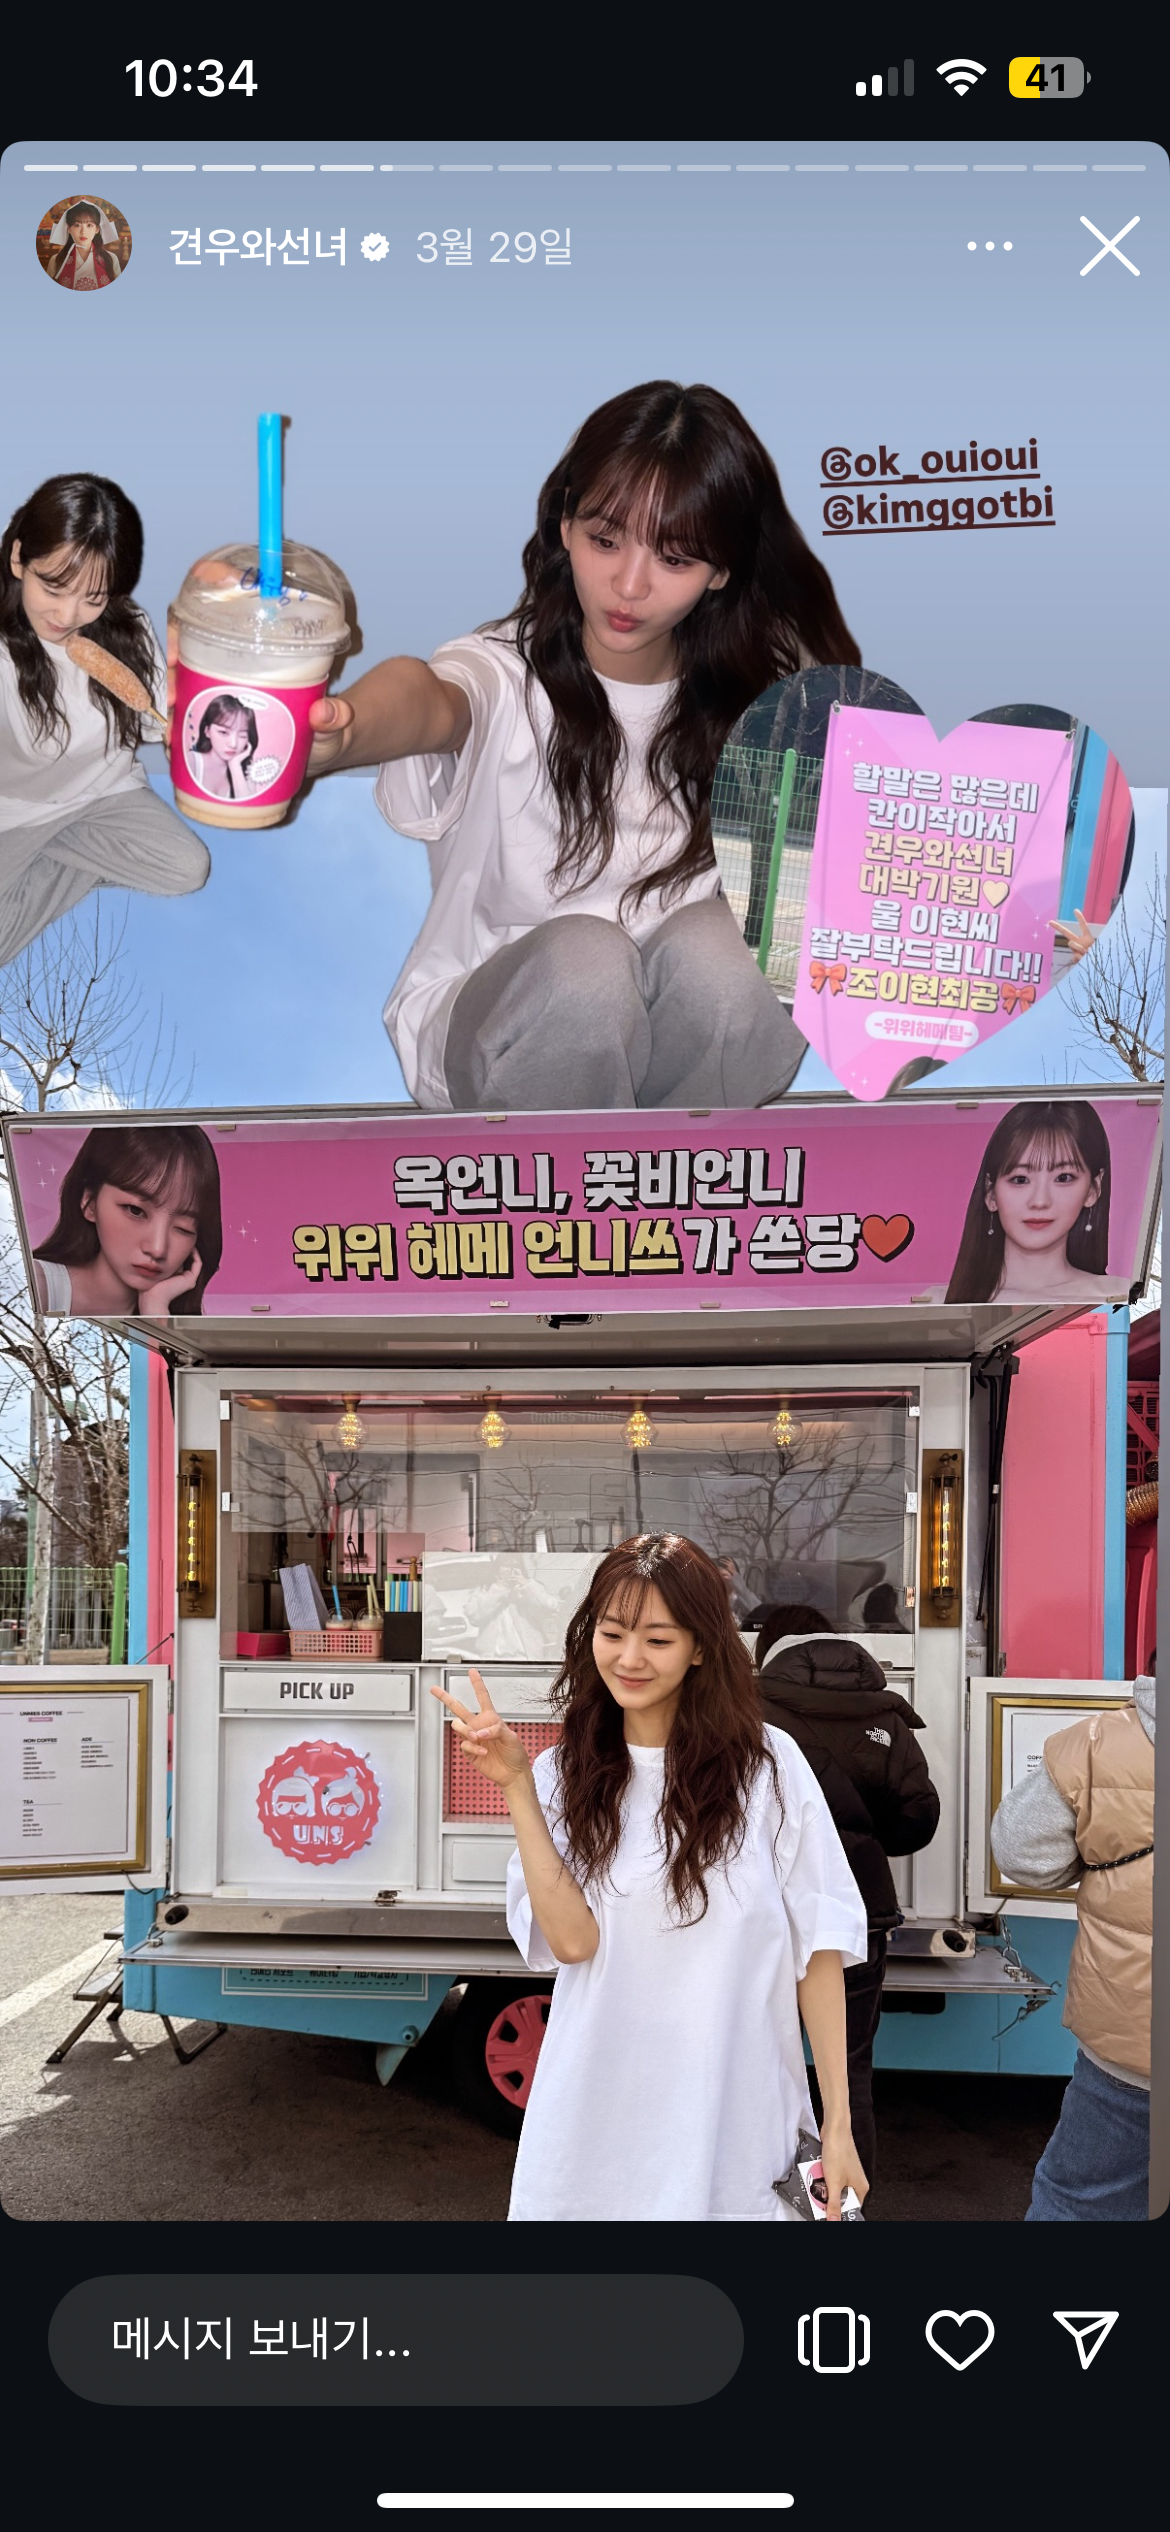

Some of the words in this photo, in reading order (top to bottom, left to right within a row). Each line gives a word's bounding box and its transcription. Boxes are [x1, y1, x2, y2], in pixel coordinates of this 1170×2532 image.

[852, 761, 942, 802] 할말은
[949, 773, 1039, 813] 많은데
[866, 797, 1018, 844] 칸이작아서
[863, 830, 1015, 878] 견우와선녀
[858, 863, 981, 908] 대박기원
[870, 899, 901, 932] 울
[909, 903, 1000, 943] 이현씨
[809, 926, 1044, 984] 잘부탁드립니다!!
[845, 966, 999, 1014] 조이현최공
[393, 1152, 573, 1215] 옥언니,
[582, 1146, 806, 1213] 꽃비언니
[292, 1222, 398, 1282] 위위
[406, 1220, 515, 1281] 헤메
[747, 1212, 862, 1275] 쏜당
[279, 1682, 324, 1700] PICK
[329, 1683, 355, 1700] UP
